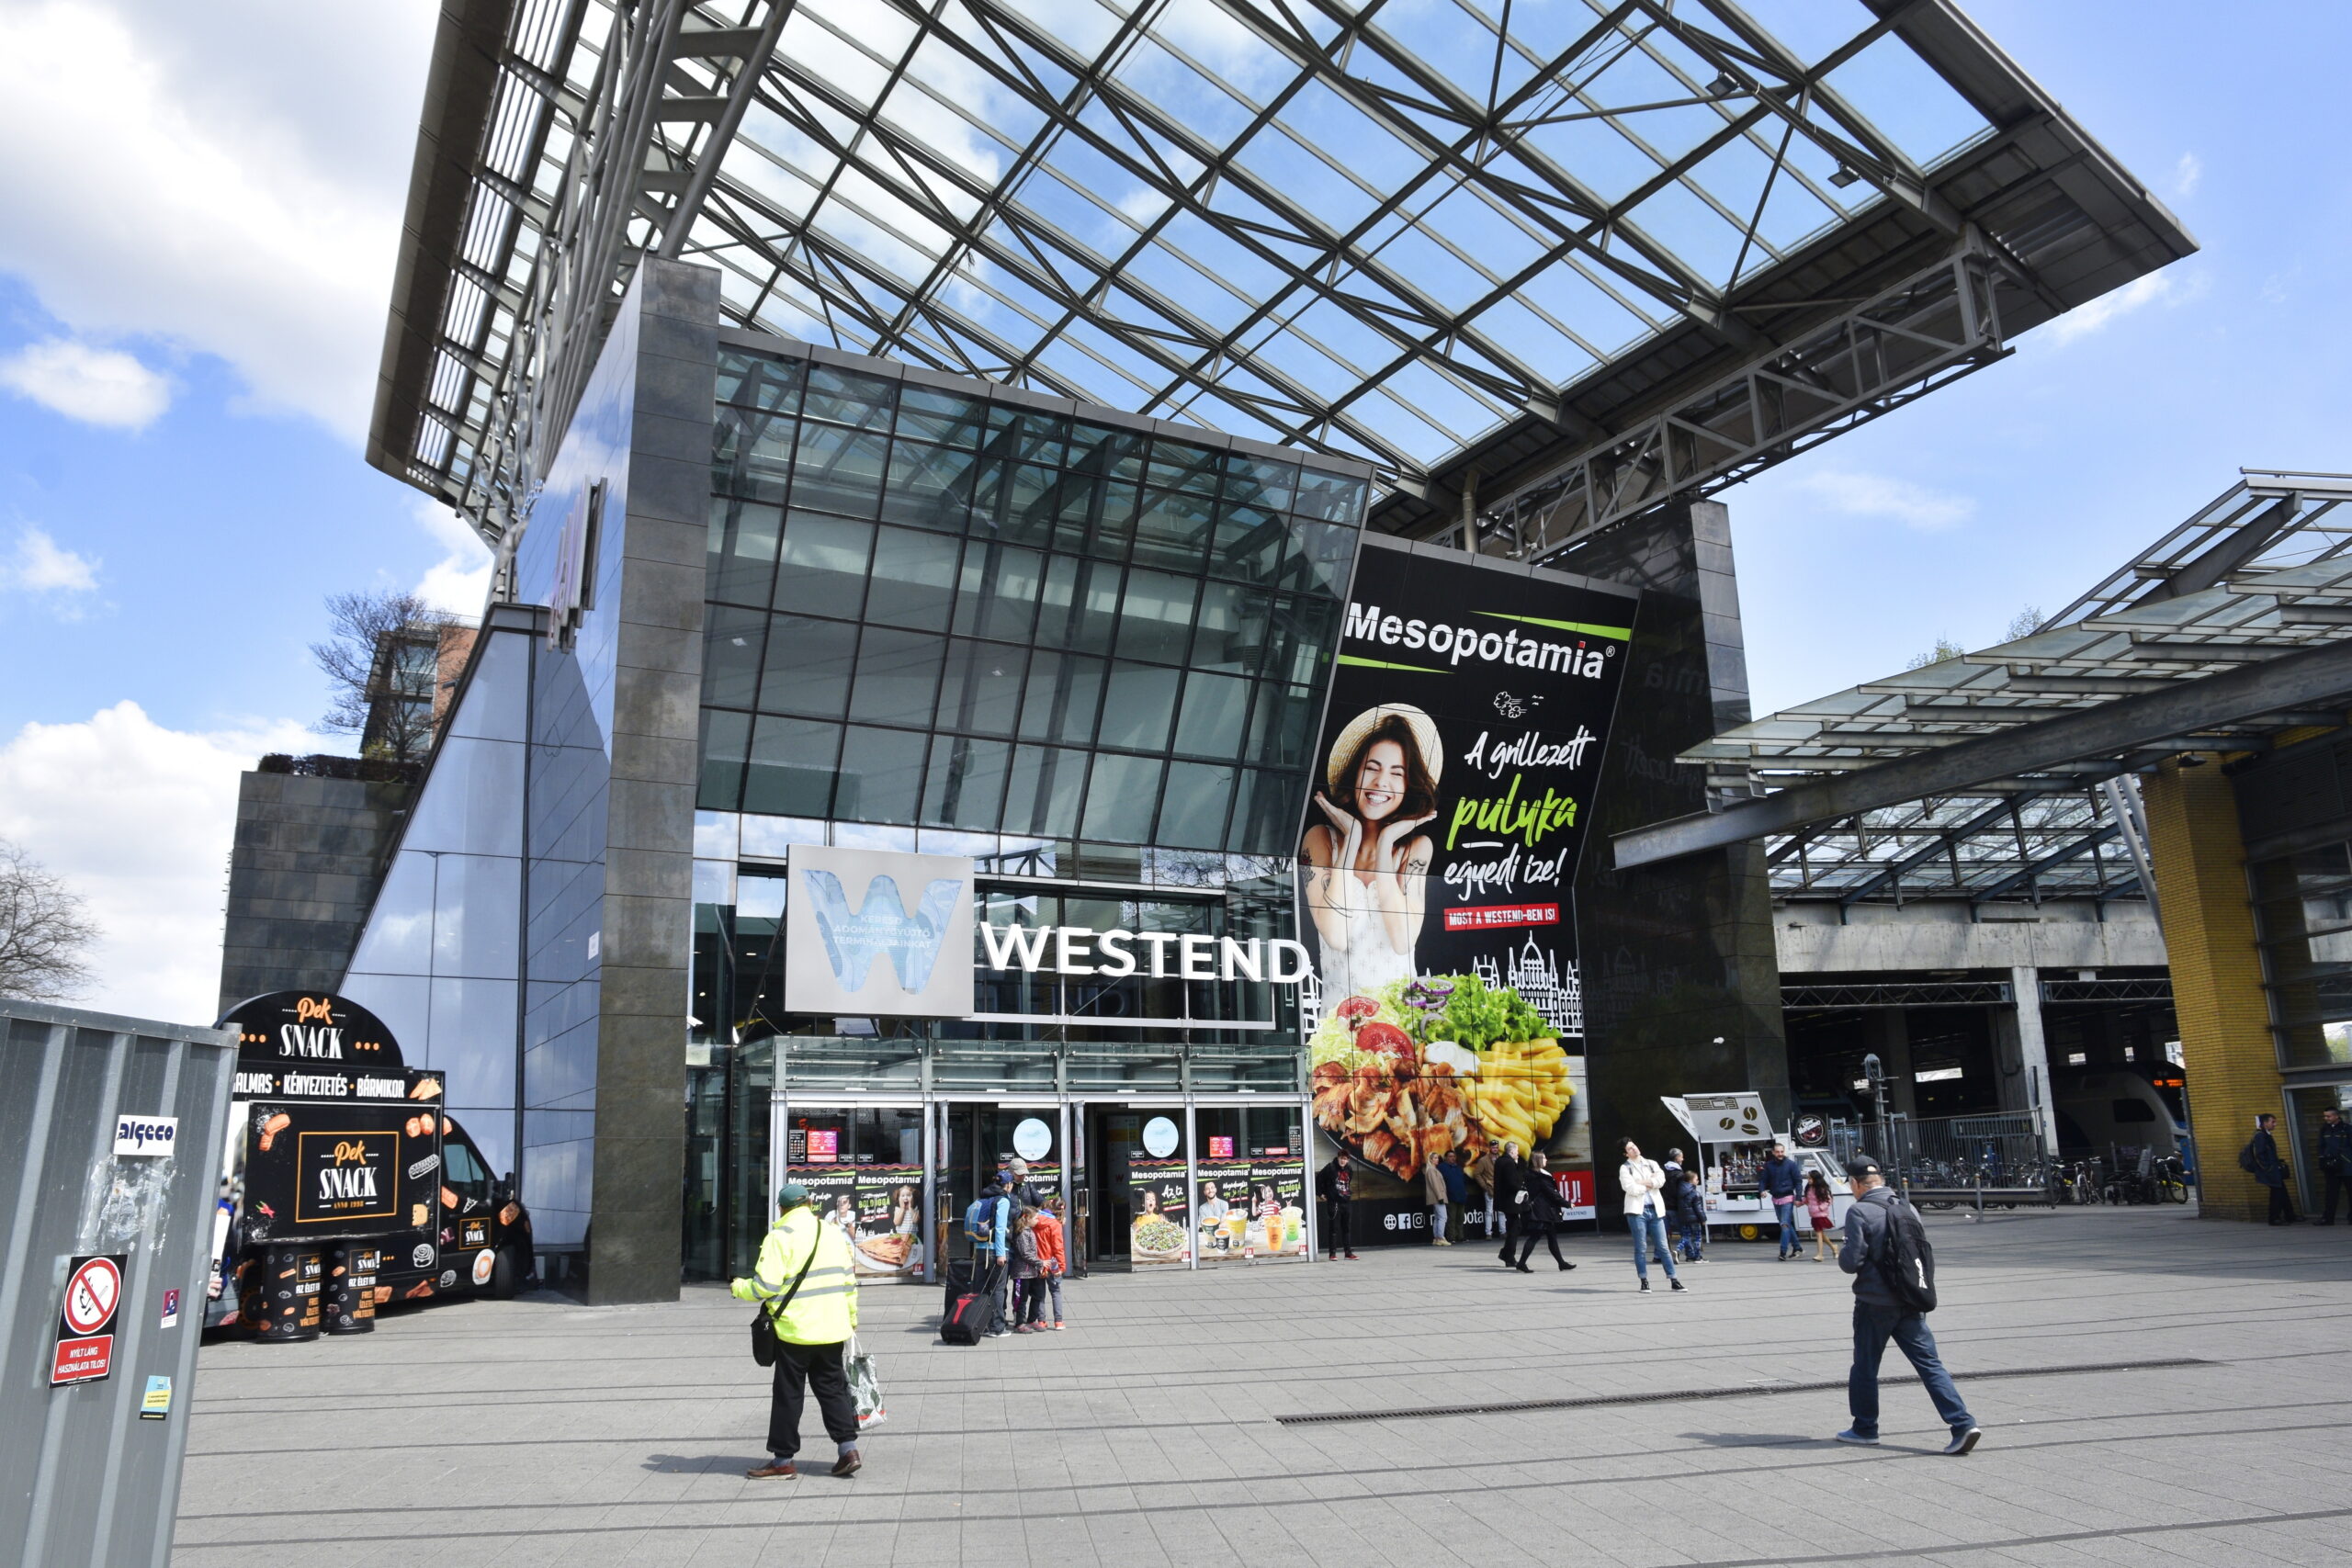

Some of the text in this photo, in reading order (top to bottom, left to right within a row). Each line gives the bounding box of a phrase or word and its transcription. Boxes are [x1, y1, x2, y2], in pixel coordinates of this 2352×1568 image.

[1464, 725, 1597, 779] A grillezett
[1446, 773, 1577, 851] pulyka
[1444, 843, 1521, 901] egyedi
[1449, 908, 1555, 926] MOST A WESTEND-BEN IS!
[979, 920, 1311, 985] WESTEND
[297, 997, 333, 1025] Pek
[279, 1023, 344, 1059] SNACK
[232, 1070, 405, 1099] ALMAS KÉNYEZTETÉS BÁRMIKOR
[334, 1140, 366, 1167] Pek
[319, 1167, 378, 1200] SNACK
